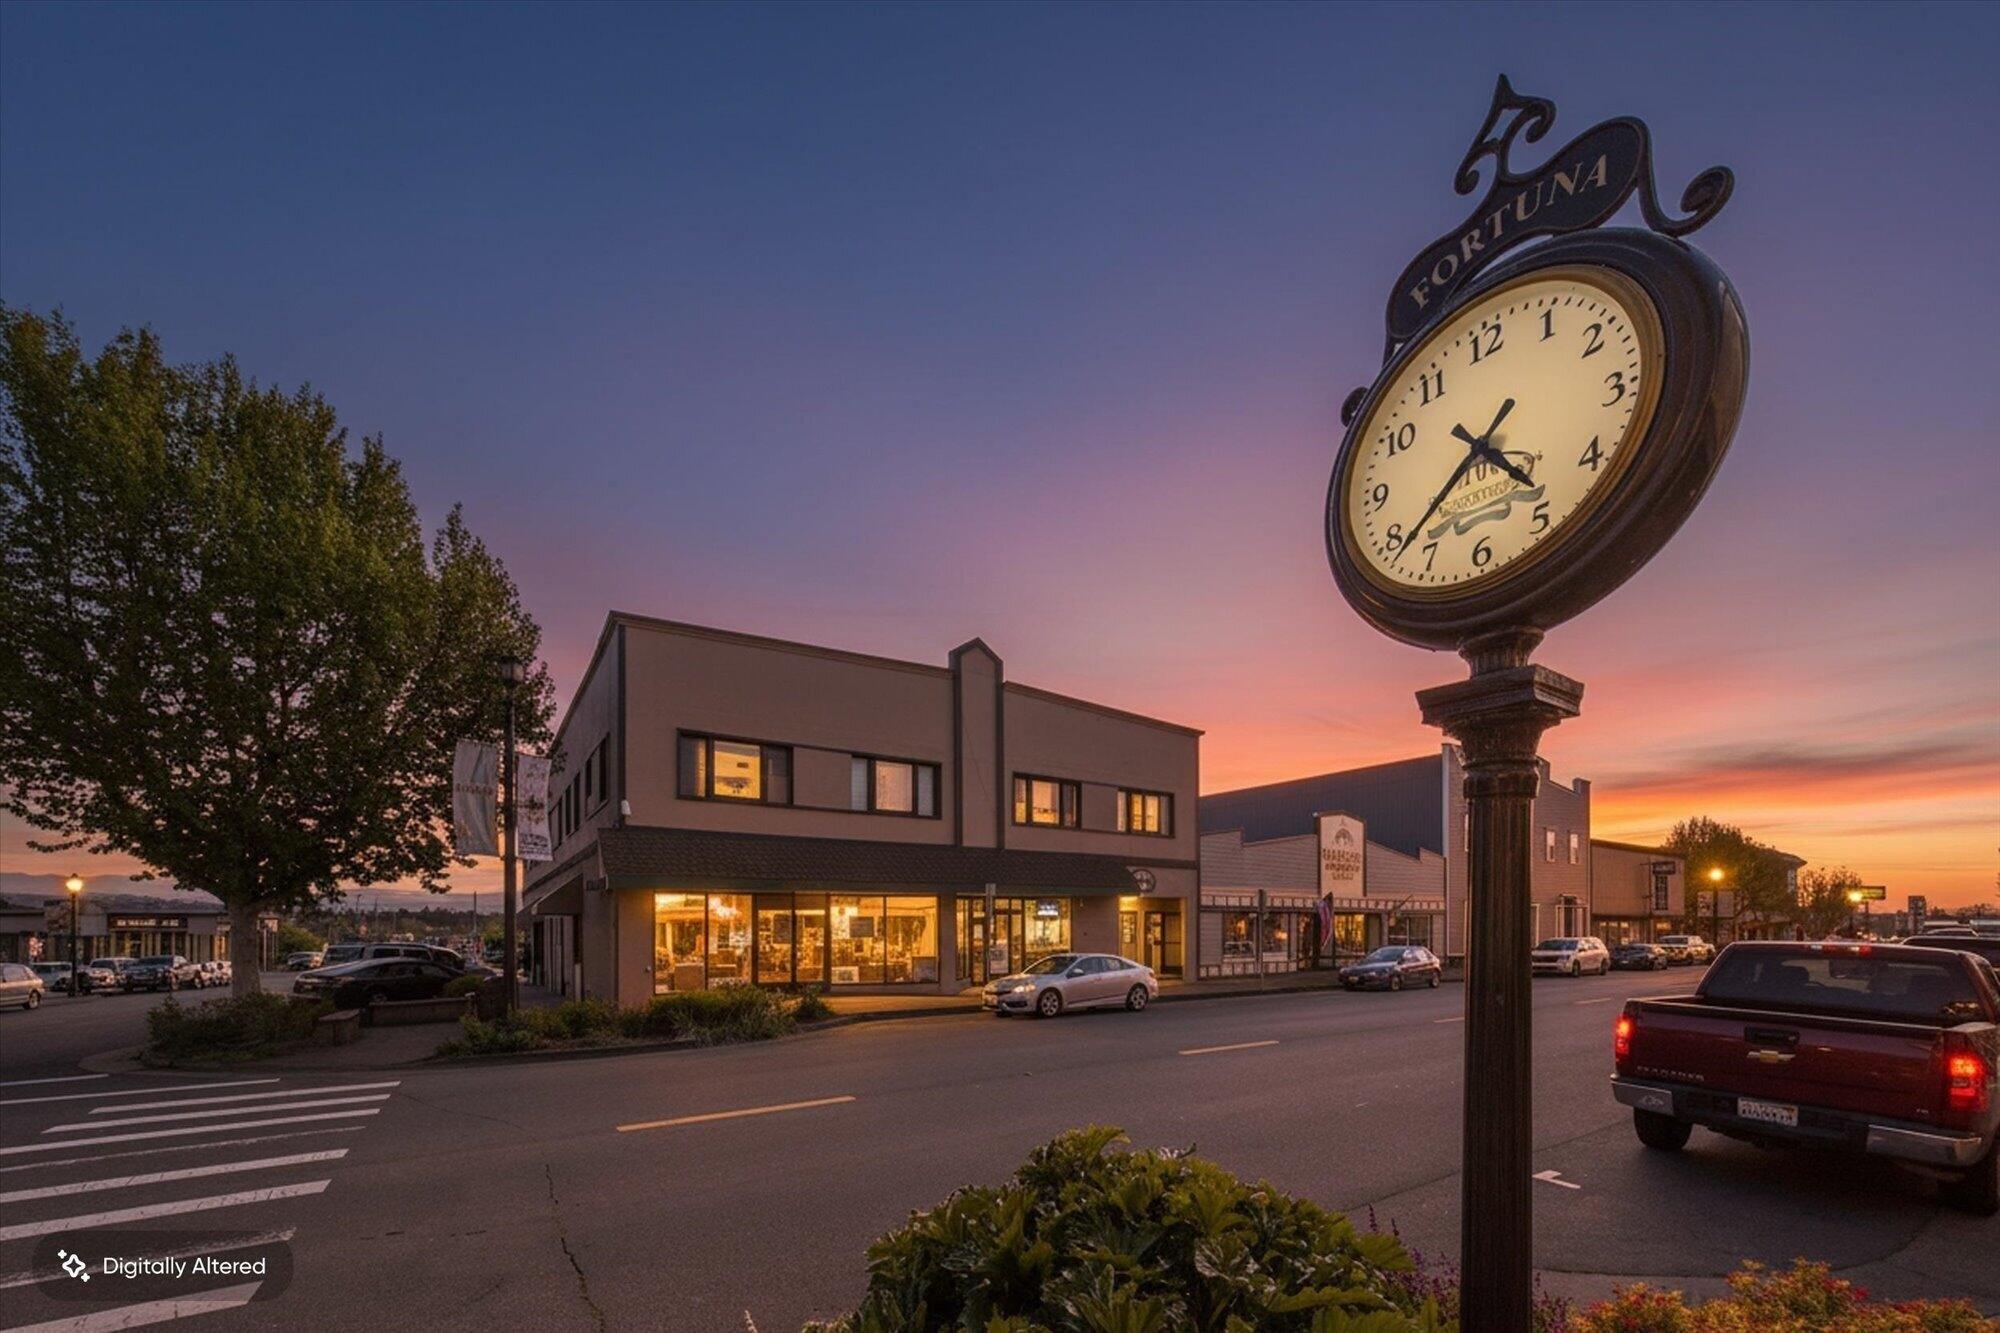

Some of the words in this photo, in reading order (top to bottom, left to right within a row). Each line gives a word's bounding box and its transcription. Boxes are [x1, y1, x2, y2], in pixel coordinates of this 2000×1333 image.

[1408, 153, 1608, 309] FORTUNA
[1539, 308, 1556, 342] 1
[1582, 322, 1605, 359] 2
[1468, 323, 1505, 367] 12
[1418, 368, 1446, 408] 11
[1602, 371, 1626, 408] 3
[1385, 422, 1416, 458] 10
[1578, 435, 1604, 472] 4
[1372, 483, 1389, 512] 9
[1529, 500, 1550, 535] 5
[1386, 523, 1403, 552] 8
[1472, 535, 1493, 567] 6
[1422, 541, 1439, 572] 7
